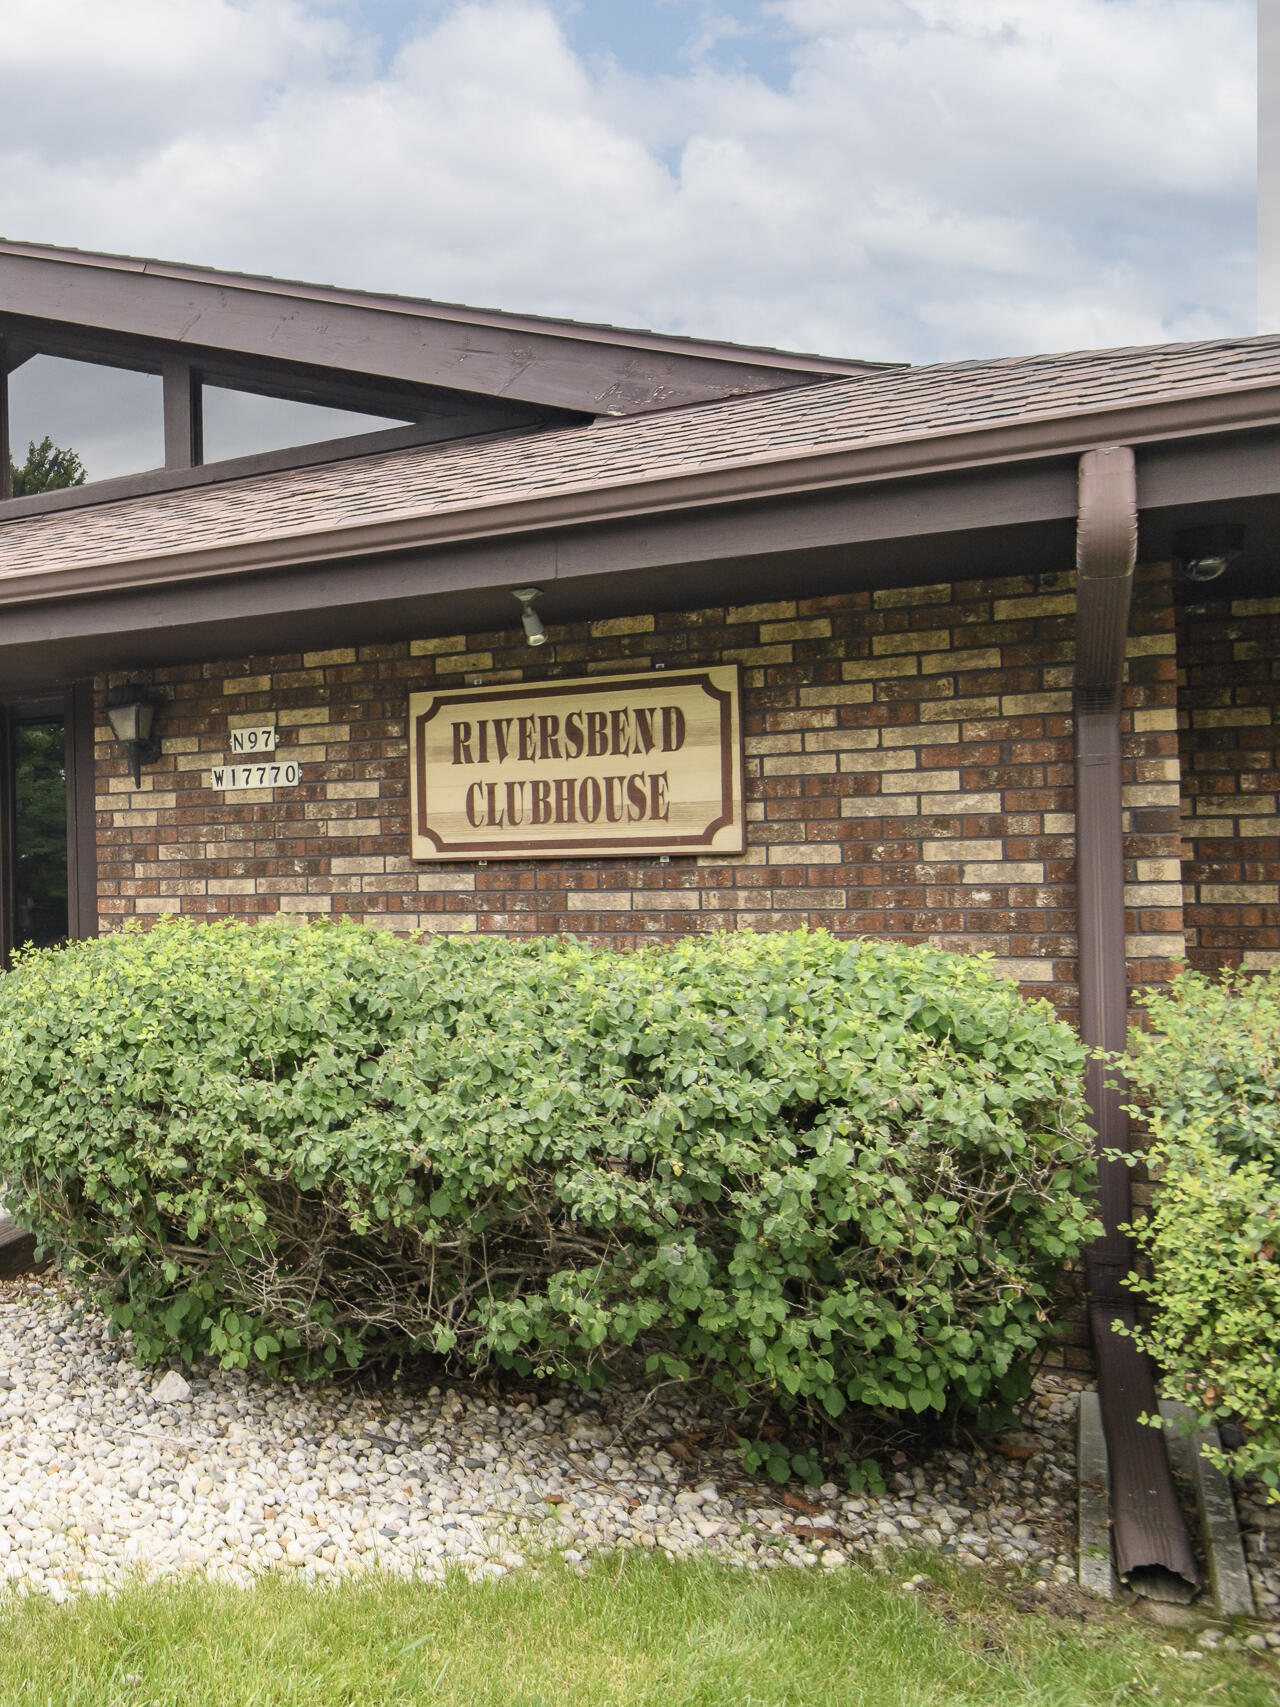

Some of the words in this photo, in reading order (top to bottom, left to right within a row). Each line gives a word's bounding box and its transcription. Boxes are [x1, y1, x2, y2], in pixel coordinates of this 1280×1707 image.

[233, 730, 272, 752] N97
[451, 705, 686, 765] RIVERSBEND
[213, 765, 296, 788] W17770
[465, 770, 671, 831] CLUBHOUSE
